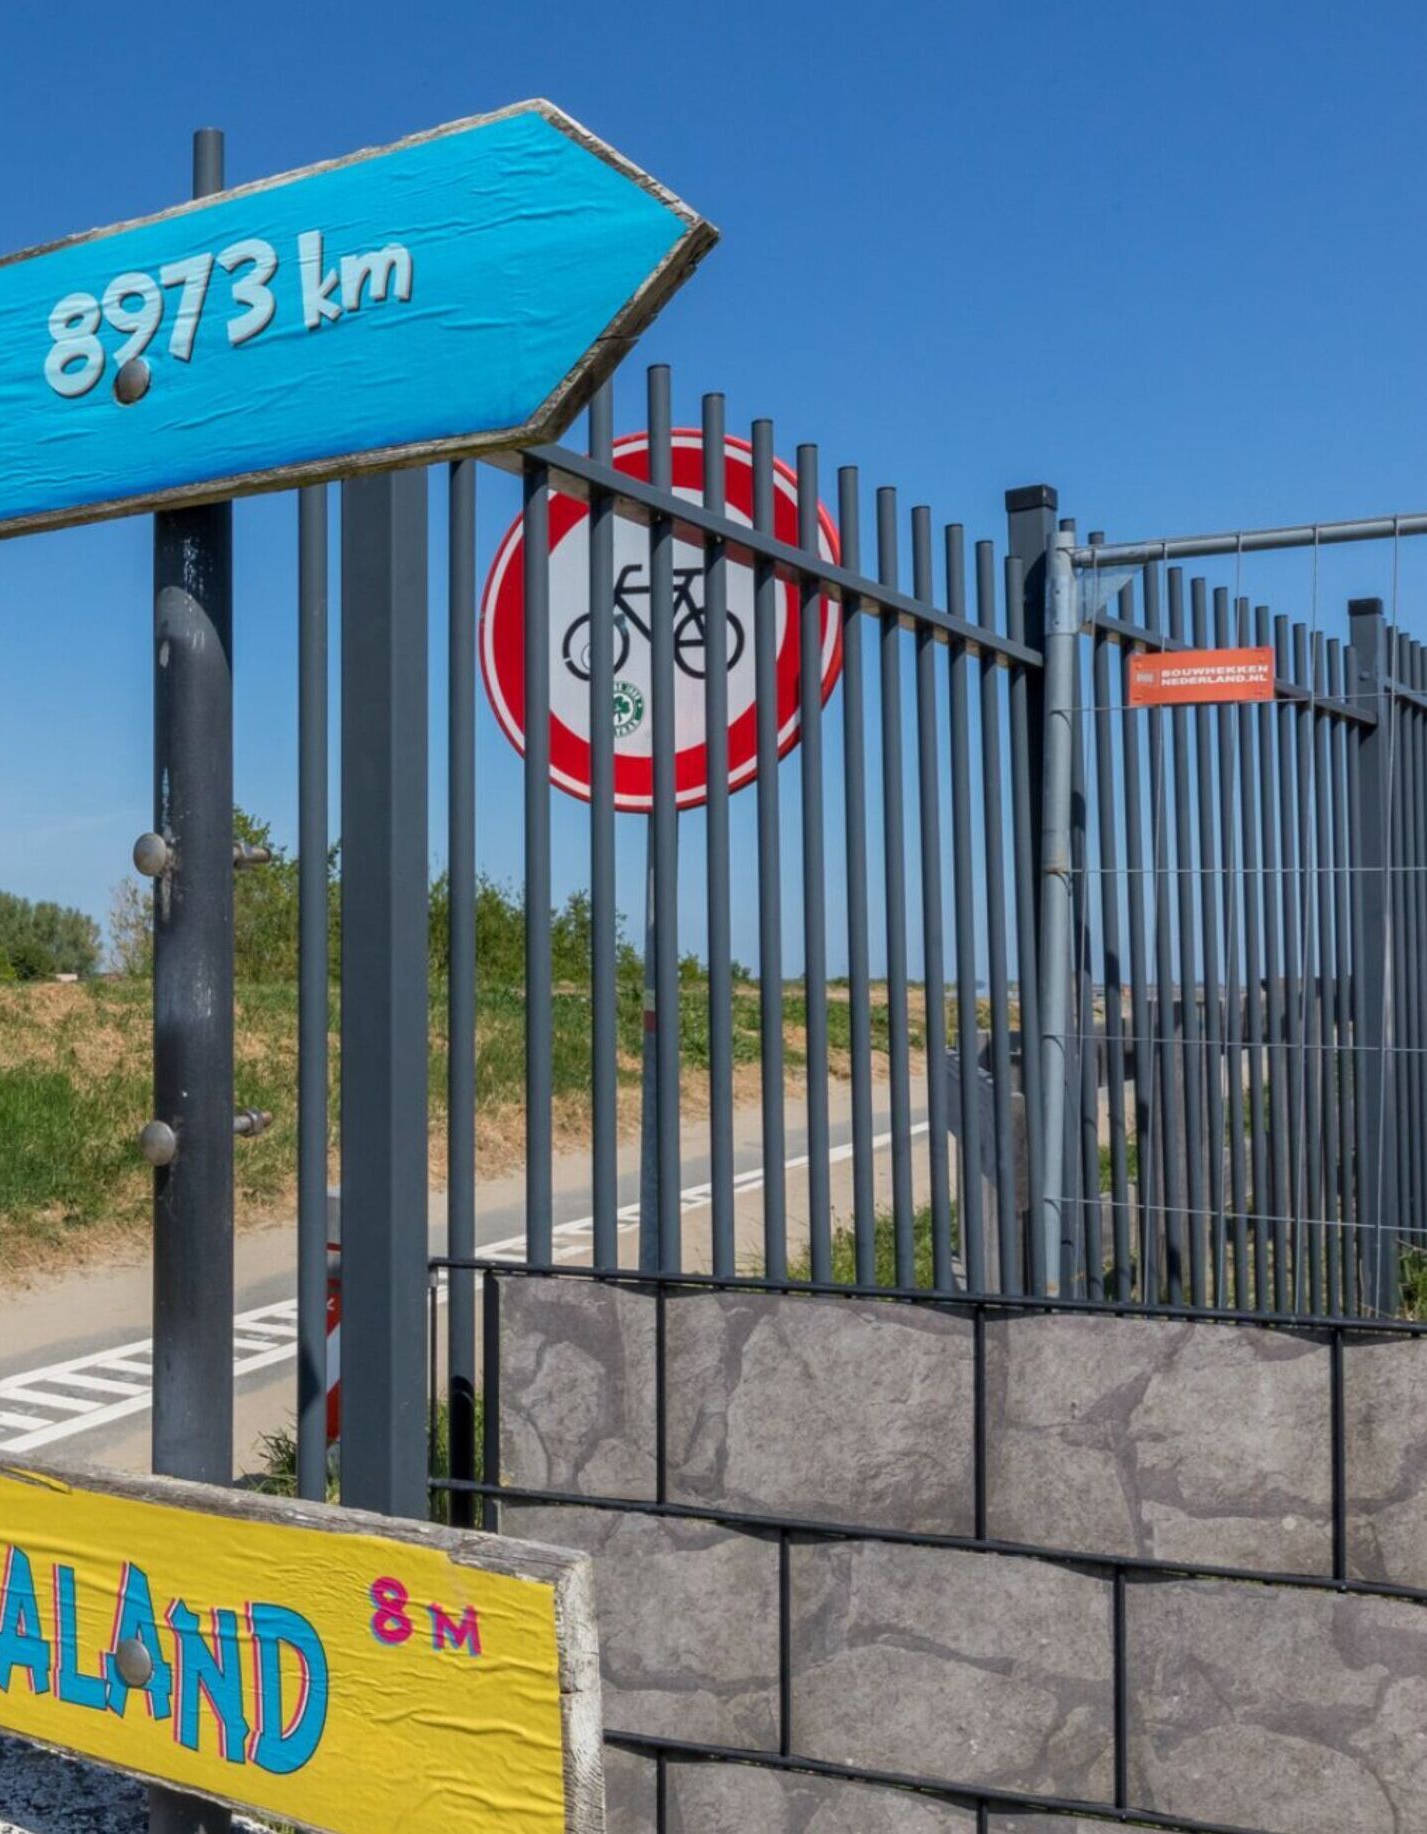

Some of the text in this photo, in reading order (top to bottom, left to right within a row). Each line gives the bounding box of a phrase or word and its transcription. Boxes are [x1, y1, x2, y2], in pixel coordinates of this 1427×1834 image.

[44, 238, 277, 398] 8973
[298, 230, 412, 331] km
[1160, 664, 1269, 678] BOUWHEKKEN
[1160, 673, 1268, 687] NEDERLAND.NL
[369, 1575, 414, 1646] 8
[426, 1602, 482, 1657] M
